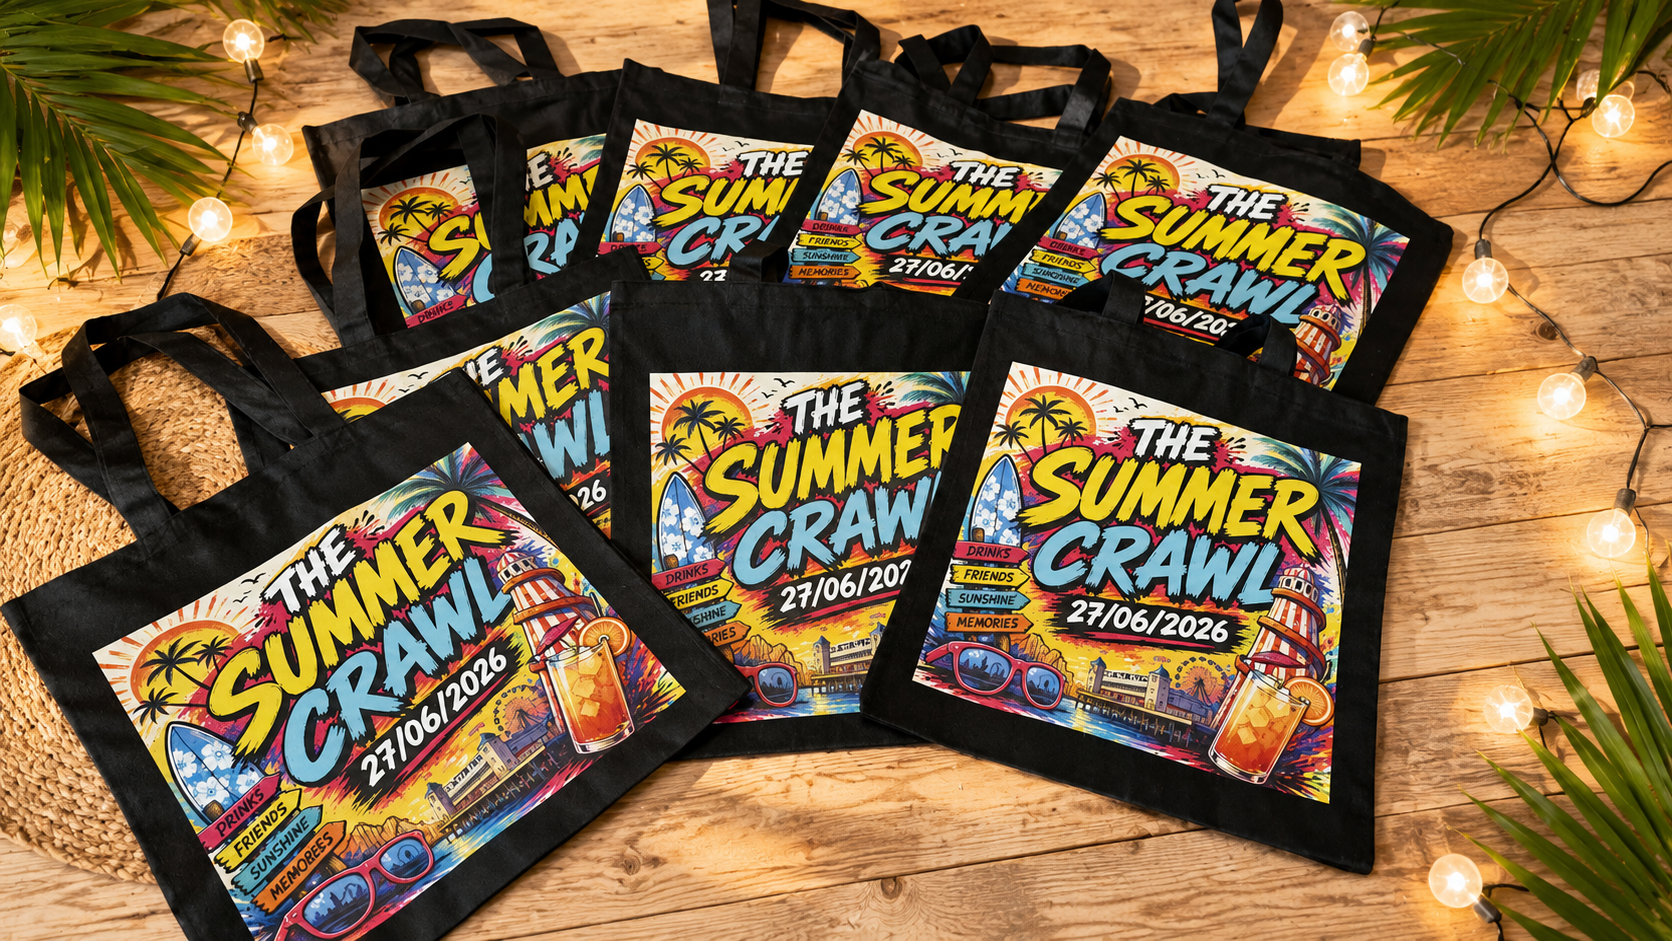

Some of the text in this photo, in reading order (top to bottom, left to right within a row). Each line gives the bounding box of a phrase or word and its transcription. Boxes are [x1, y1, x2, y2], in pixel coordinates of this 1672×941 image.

[739, 151, 808, 177] THE
[951, 161, 1020, 187] THE
[655, 175, 799, 227] SUM
[859, 170, 1046, 224] SUMM
[1208, 185, 1287, 220] THE
[866, 212, 1012, 257] CRA
[1101, 195, 1366, 300] SUMMER
[889, 258, 974, 280] 27/06/
[1101, 242, 1317, 324] CRAWL
[498, 327, 609, 427] MER
[786, 381, 867, 434] THE
[1131, 419, 1218, 461] THE
[733, 471, 941, 585] CRAW
[1018, 446, 1320, 560] SUMMER
[264, 527, 355, 613] THE
[666, 563, 708, 585] DRINKS
[964, 569, 1014, 582] FRIENDS
[966, 546, 1011, 558] DRINKS
[1033, 521, 1281, 604] CRAWL
[209, 490, 507, 757] SUMMER
[956, 617, 1018, 629] MEMORIES
[958, 594, 1015, 605] SUNSHINE
[1067, 600, 1228, 642] 27/06/2026
[711, 627, 736, 643] RIES
[283, 557, 511, 783] CRAWL
[361, 647, 507, 787] 27/06/2026
[233, 802, 287, 858] FRIENDS
[250, 816, 310, 880] SUNSHINE
